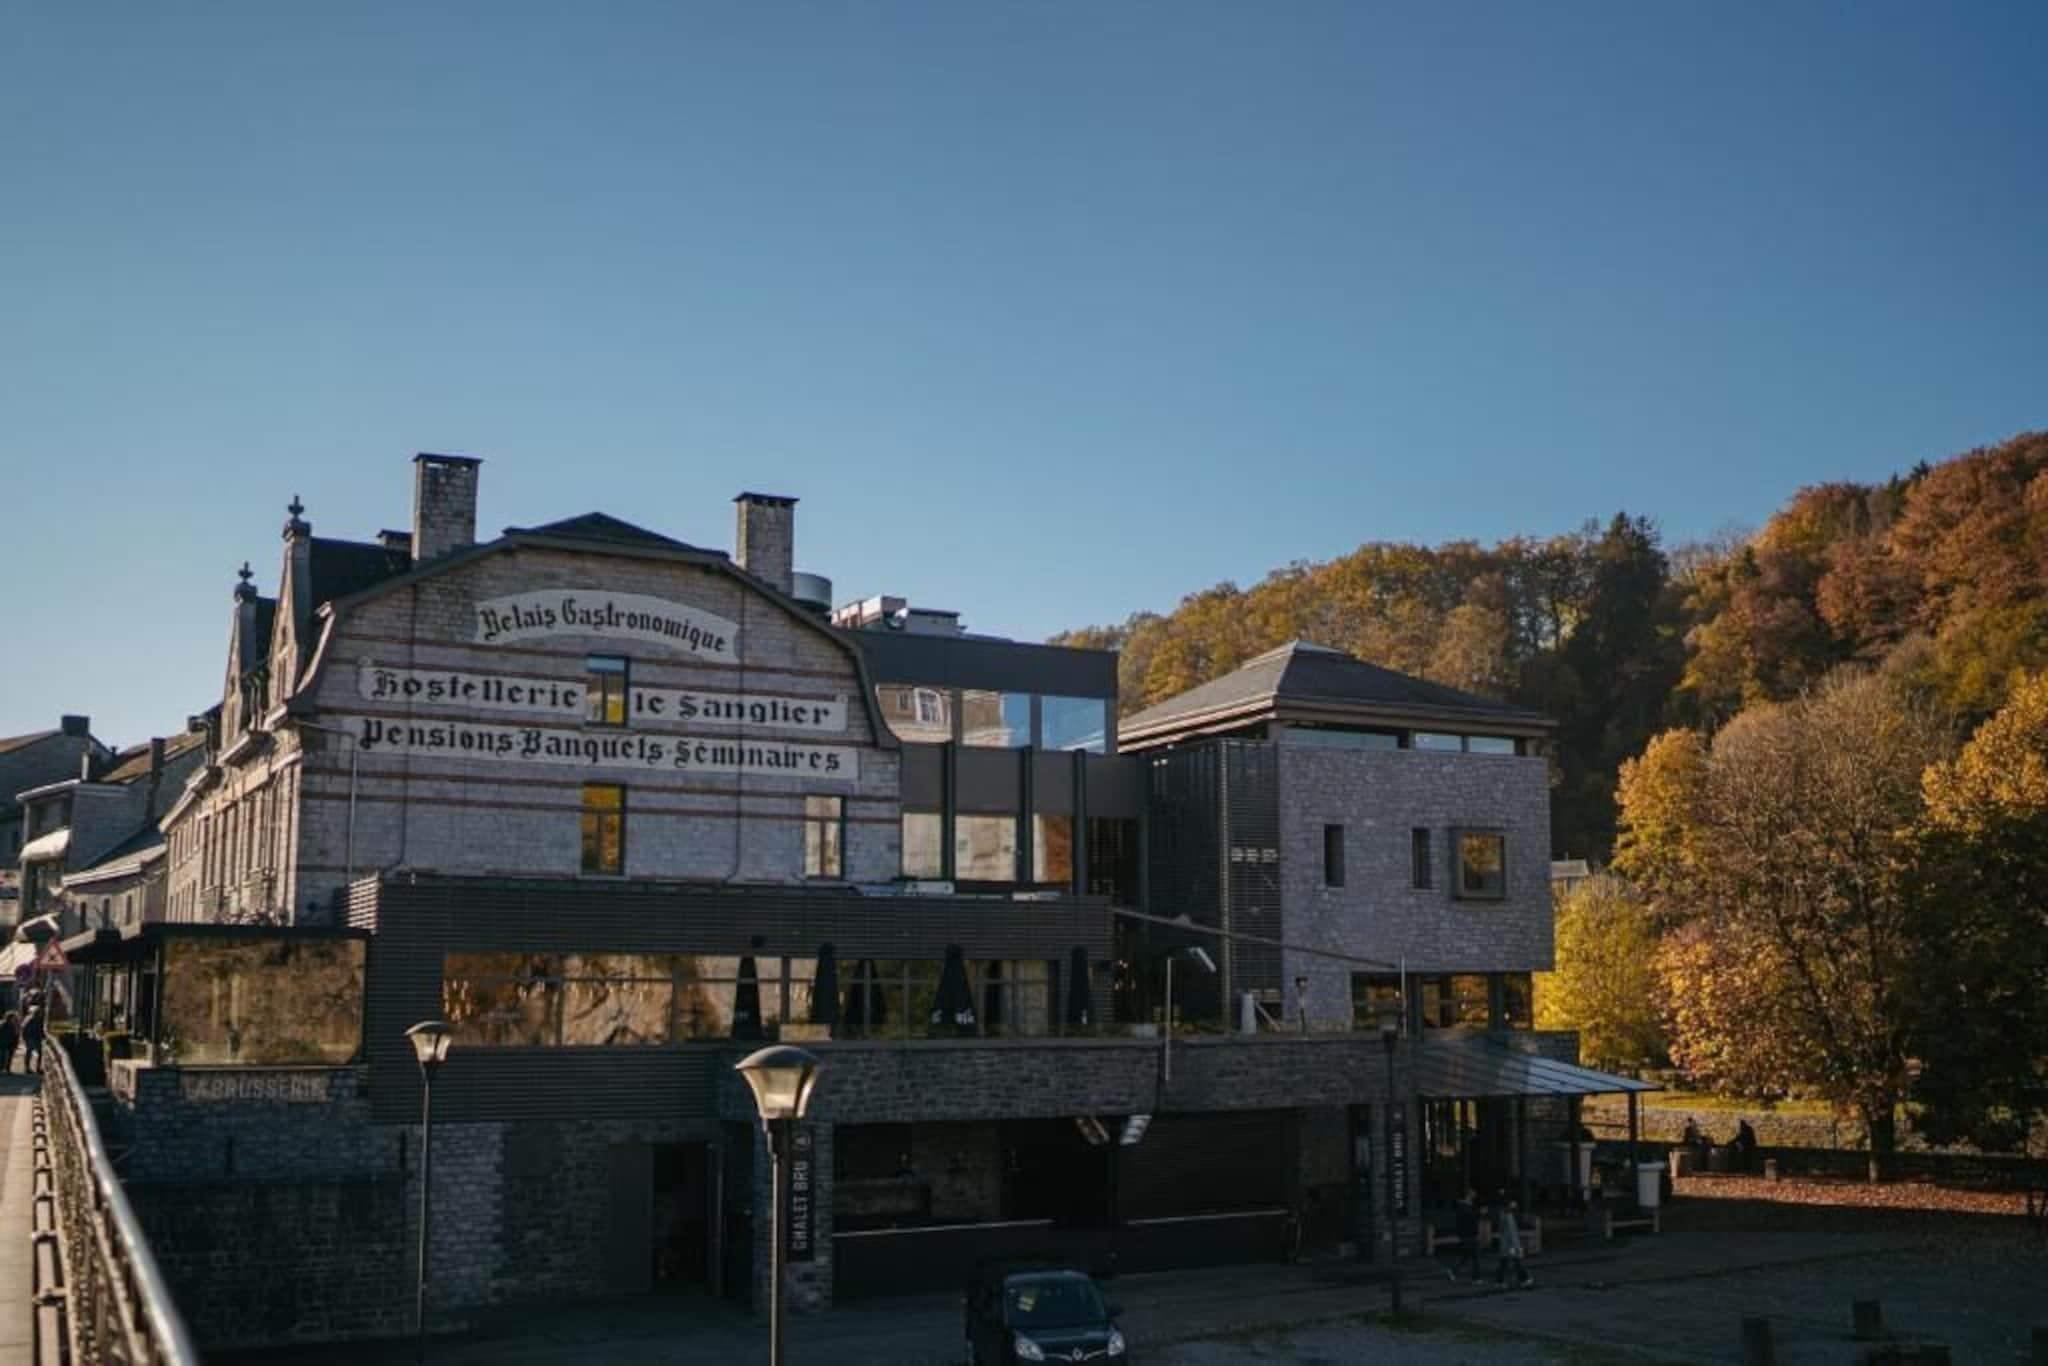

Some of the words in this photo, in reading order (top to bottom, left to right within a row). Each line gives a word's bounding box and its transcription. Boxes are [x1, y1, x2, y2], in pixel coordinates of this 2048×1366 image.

[479, 603, 556, 640] Relais
[562, 597, 726, 652] Gastronomique
[372, 670, 578, 707] Hostellerie
[679, 695, 830, 725] Sanglier
